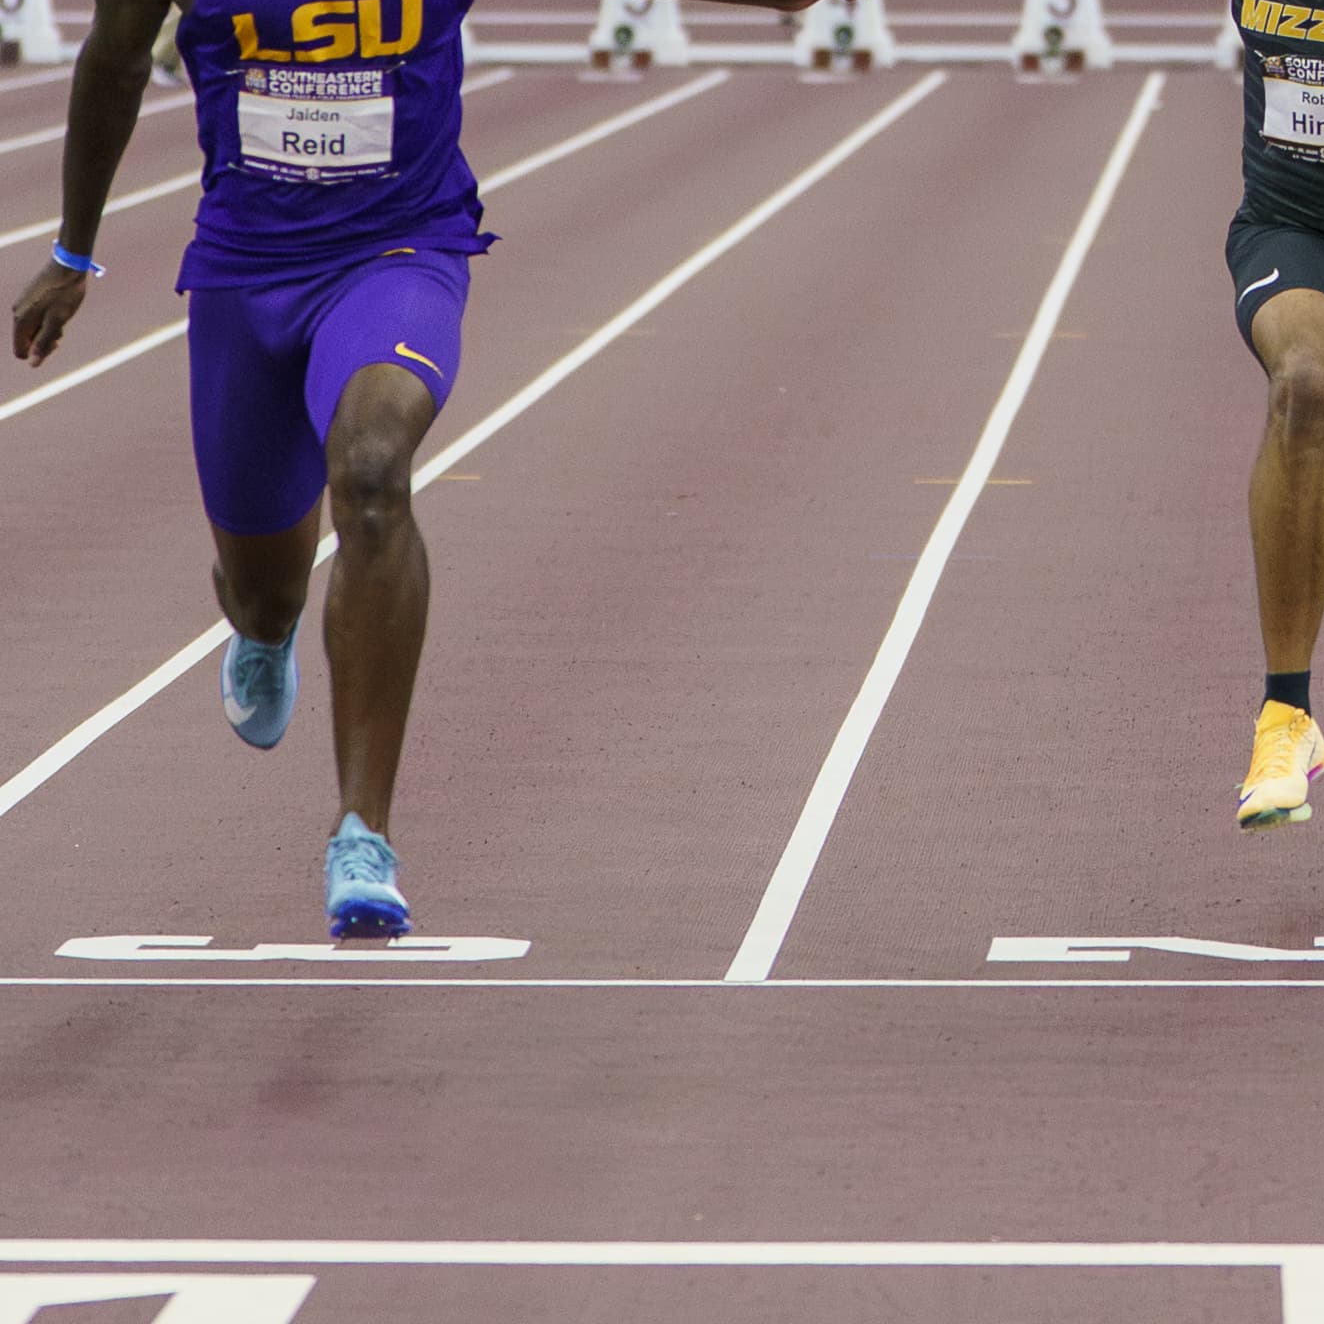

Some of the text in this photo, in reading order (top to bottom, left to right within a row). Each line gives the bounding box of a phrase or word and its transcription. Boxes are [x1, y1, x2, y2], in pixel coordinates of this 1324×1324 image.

[269, 69, 383, 83] SOUTHEASTERN
[269, 80, 382, 94] CONFERENCE
[286, 108, 340, 122] Jaiden
[282, 131, 345, 155] Reid
[55, 935, 531, 961] 3
